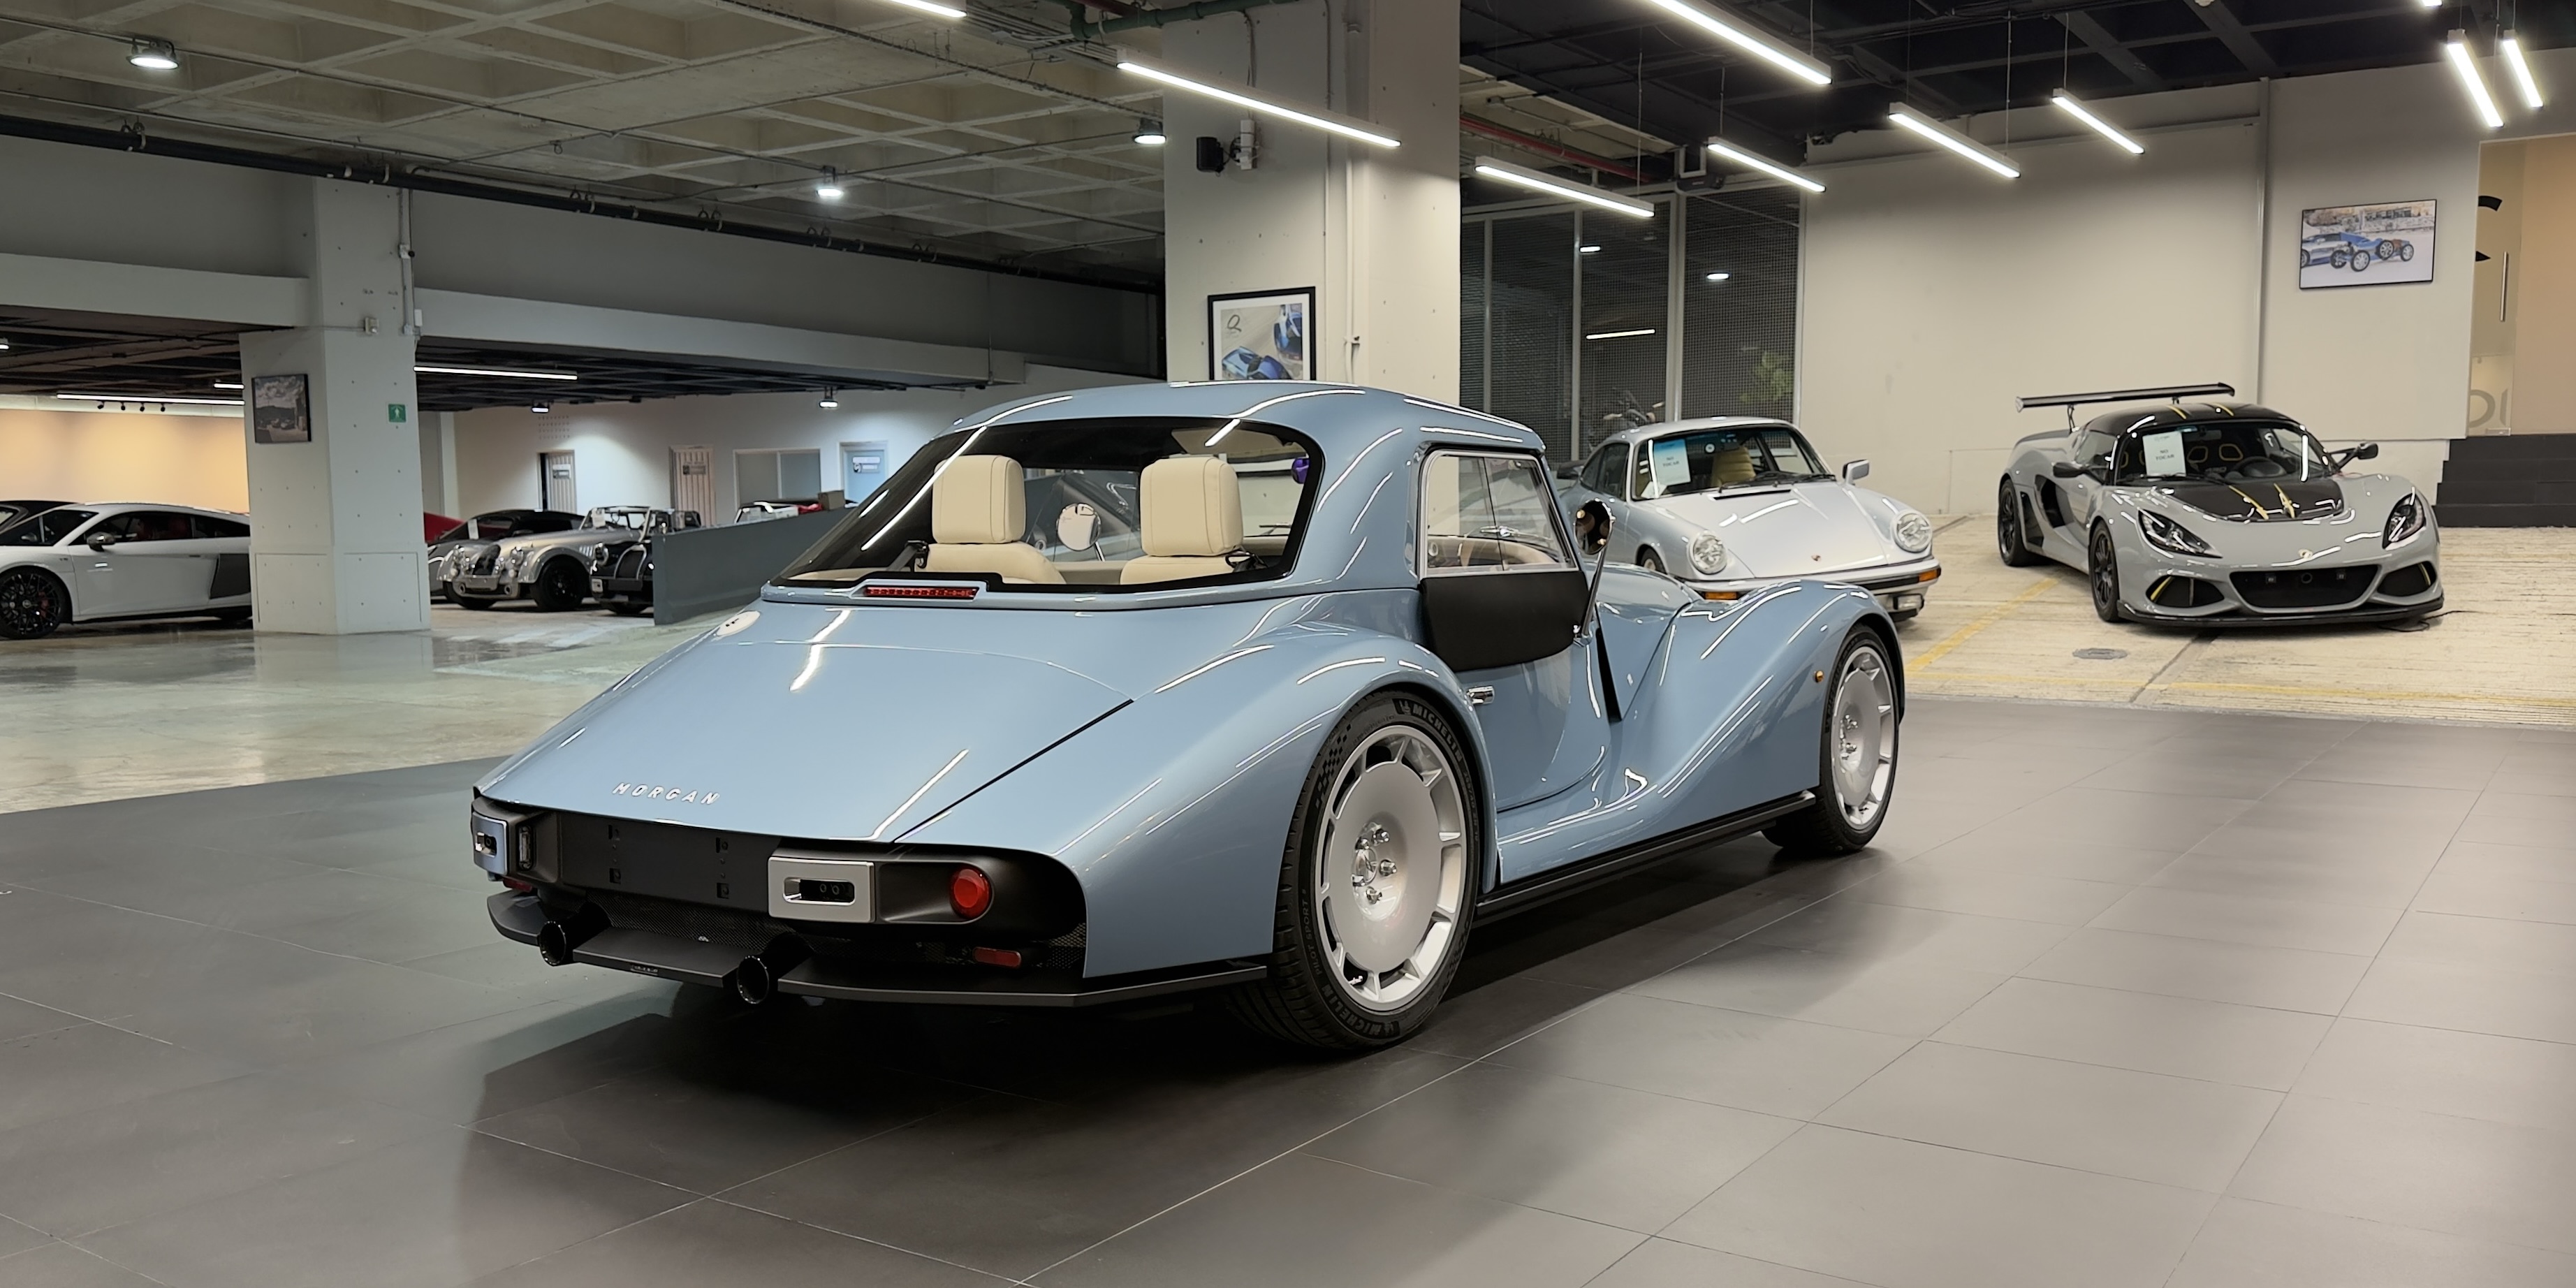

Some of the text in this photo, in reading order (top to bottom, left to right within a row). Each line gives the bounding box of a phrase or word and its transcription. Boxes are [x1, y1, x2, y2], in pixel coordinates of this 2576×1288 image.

[1227, 314, 1242, 332] Q
[1412, 703, 1463, 763] MICHELIN
[612, 782, 720, 805] MORGAN
[1301, 898, 1313, 940] SPORT
[1308, 944, 1323, 976] PILOT
[1321, 983, 1383, 1036] MICHELIN
